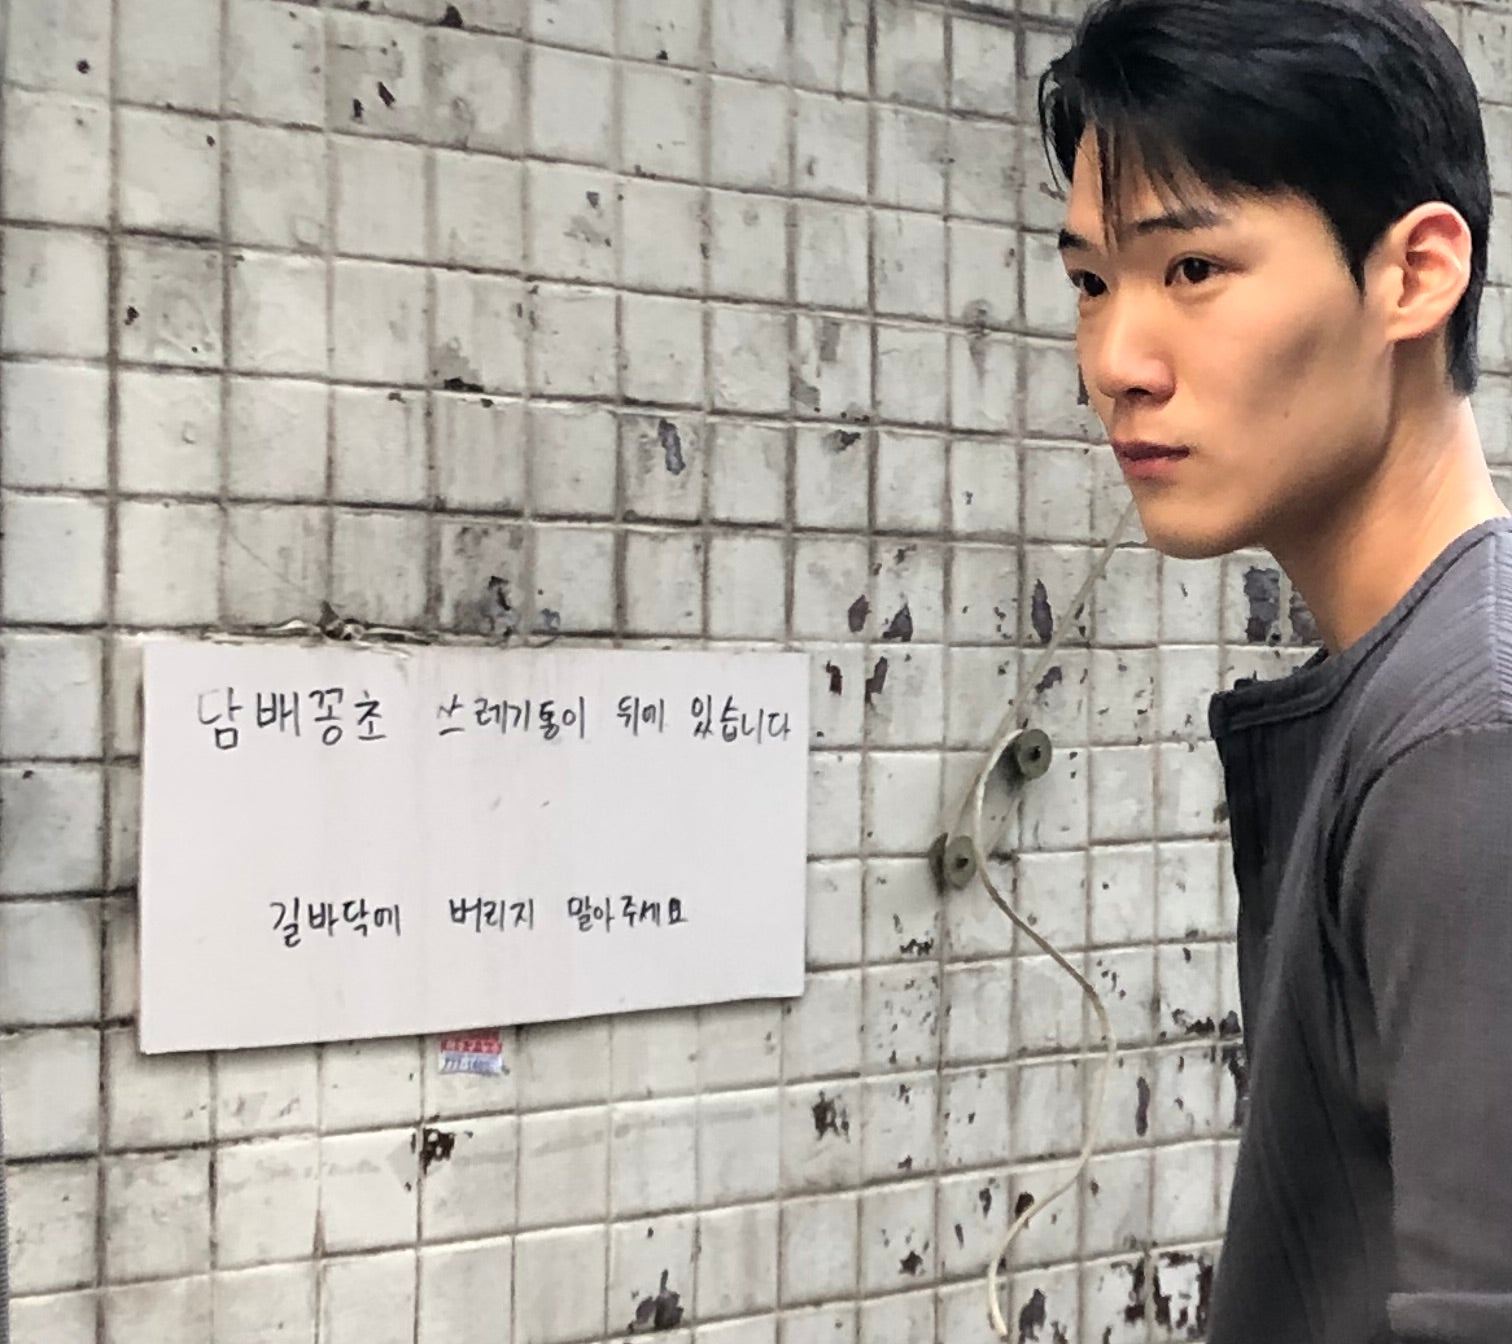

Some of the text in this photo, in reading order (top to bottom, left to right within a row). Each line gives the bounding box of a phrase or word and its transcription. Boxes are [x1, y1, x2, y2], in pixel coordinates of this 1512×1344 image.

[198, 686, 387, 750] 담배꽁초
[616, 695, 664, 737] 뒤에
[690, 693, 792, 746] 있습니다
[268, 895, 402, 948] 길바닥에
[448, 897, 535, 933] 버리지
